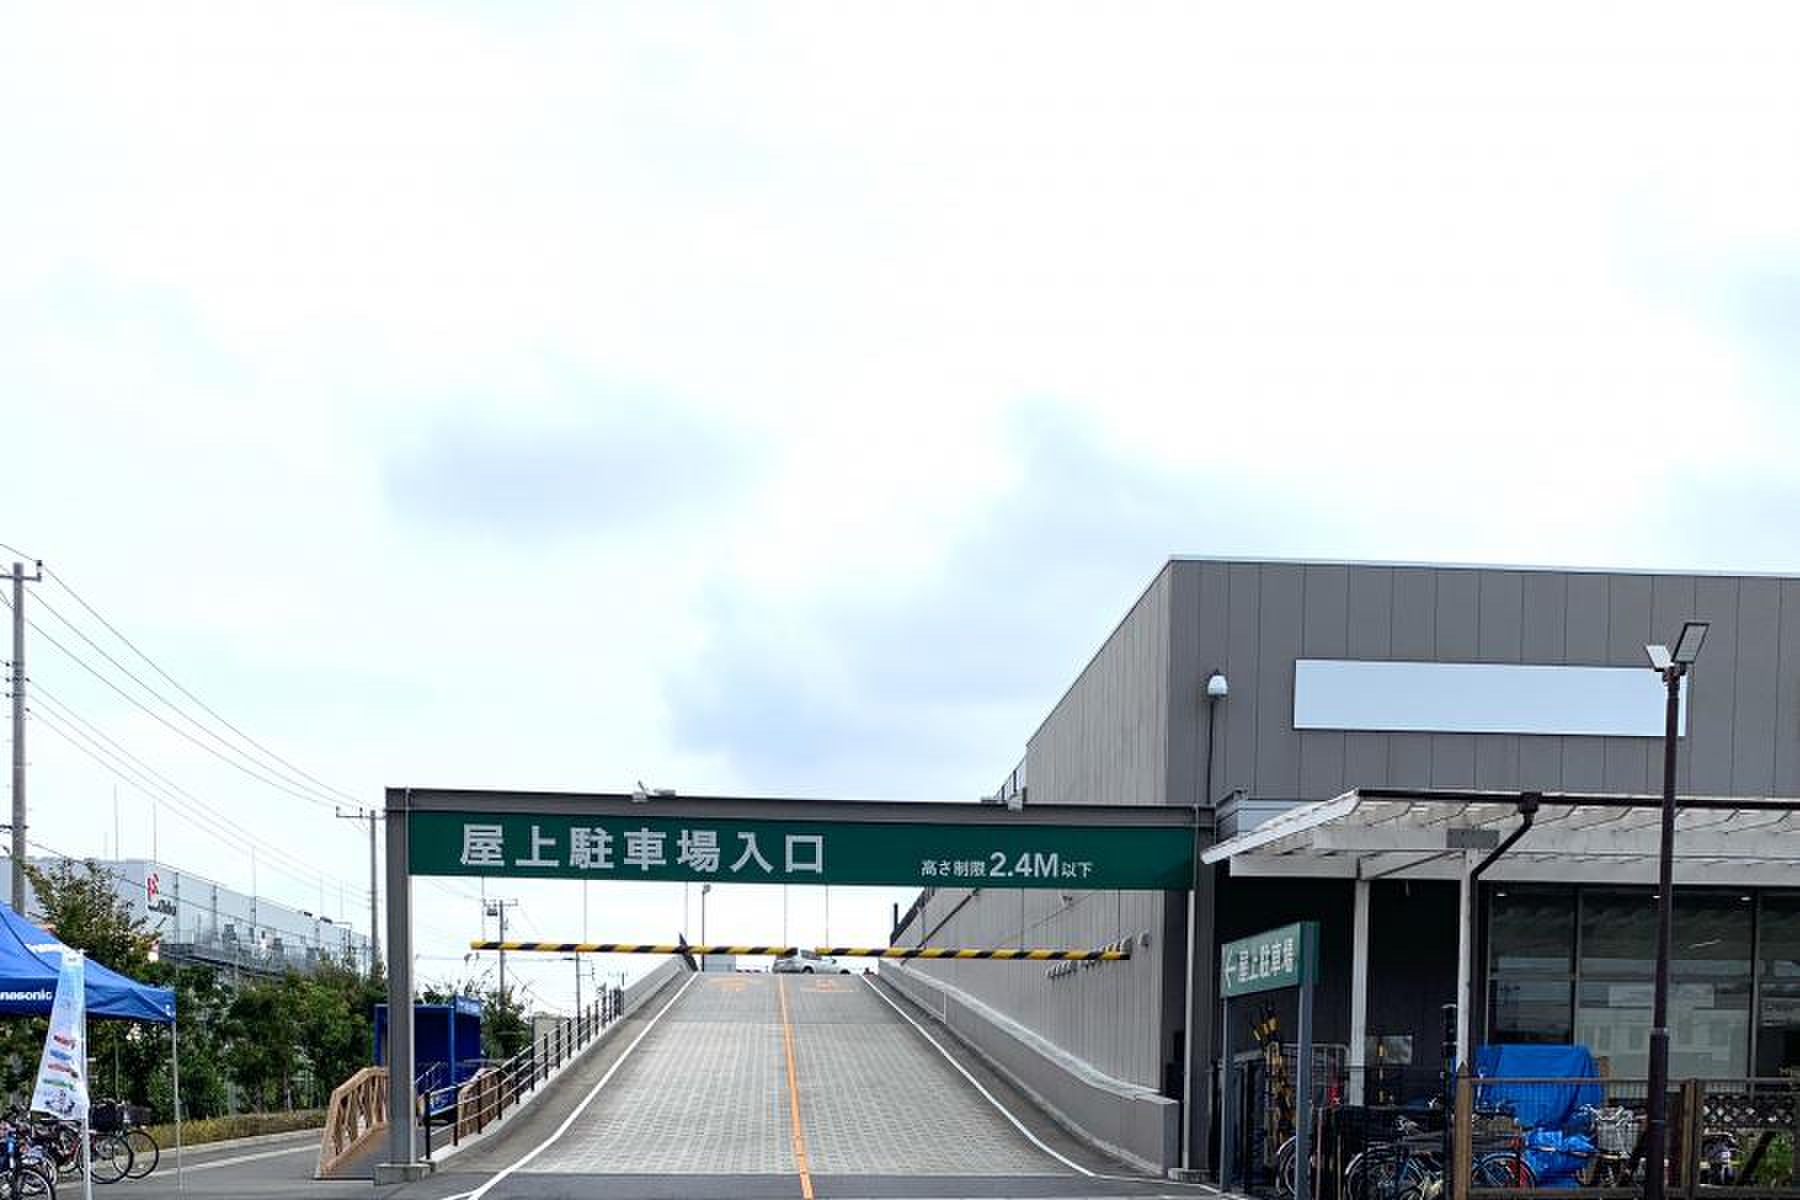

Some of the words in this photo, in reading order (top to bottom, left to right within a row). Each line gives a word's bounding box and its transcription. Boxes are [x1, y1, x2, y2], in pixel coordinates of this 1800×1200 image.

[460, 824, 825, 873] 屋上駐車場入口
[1238, 938, 1294, 982] 屋上駐車場
